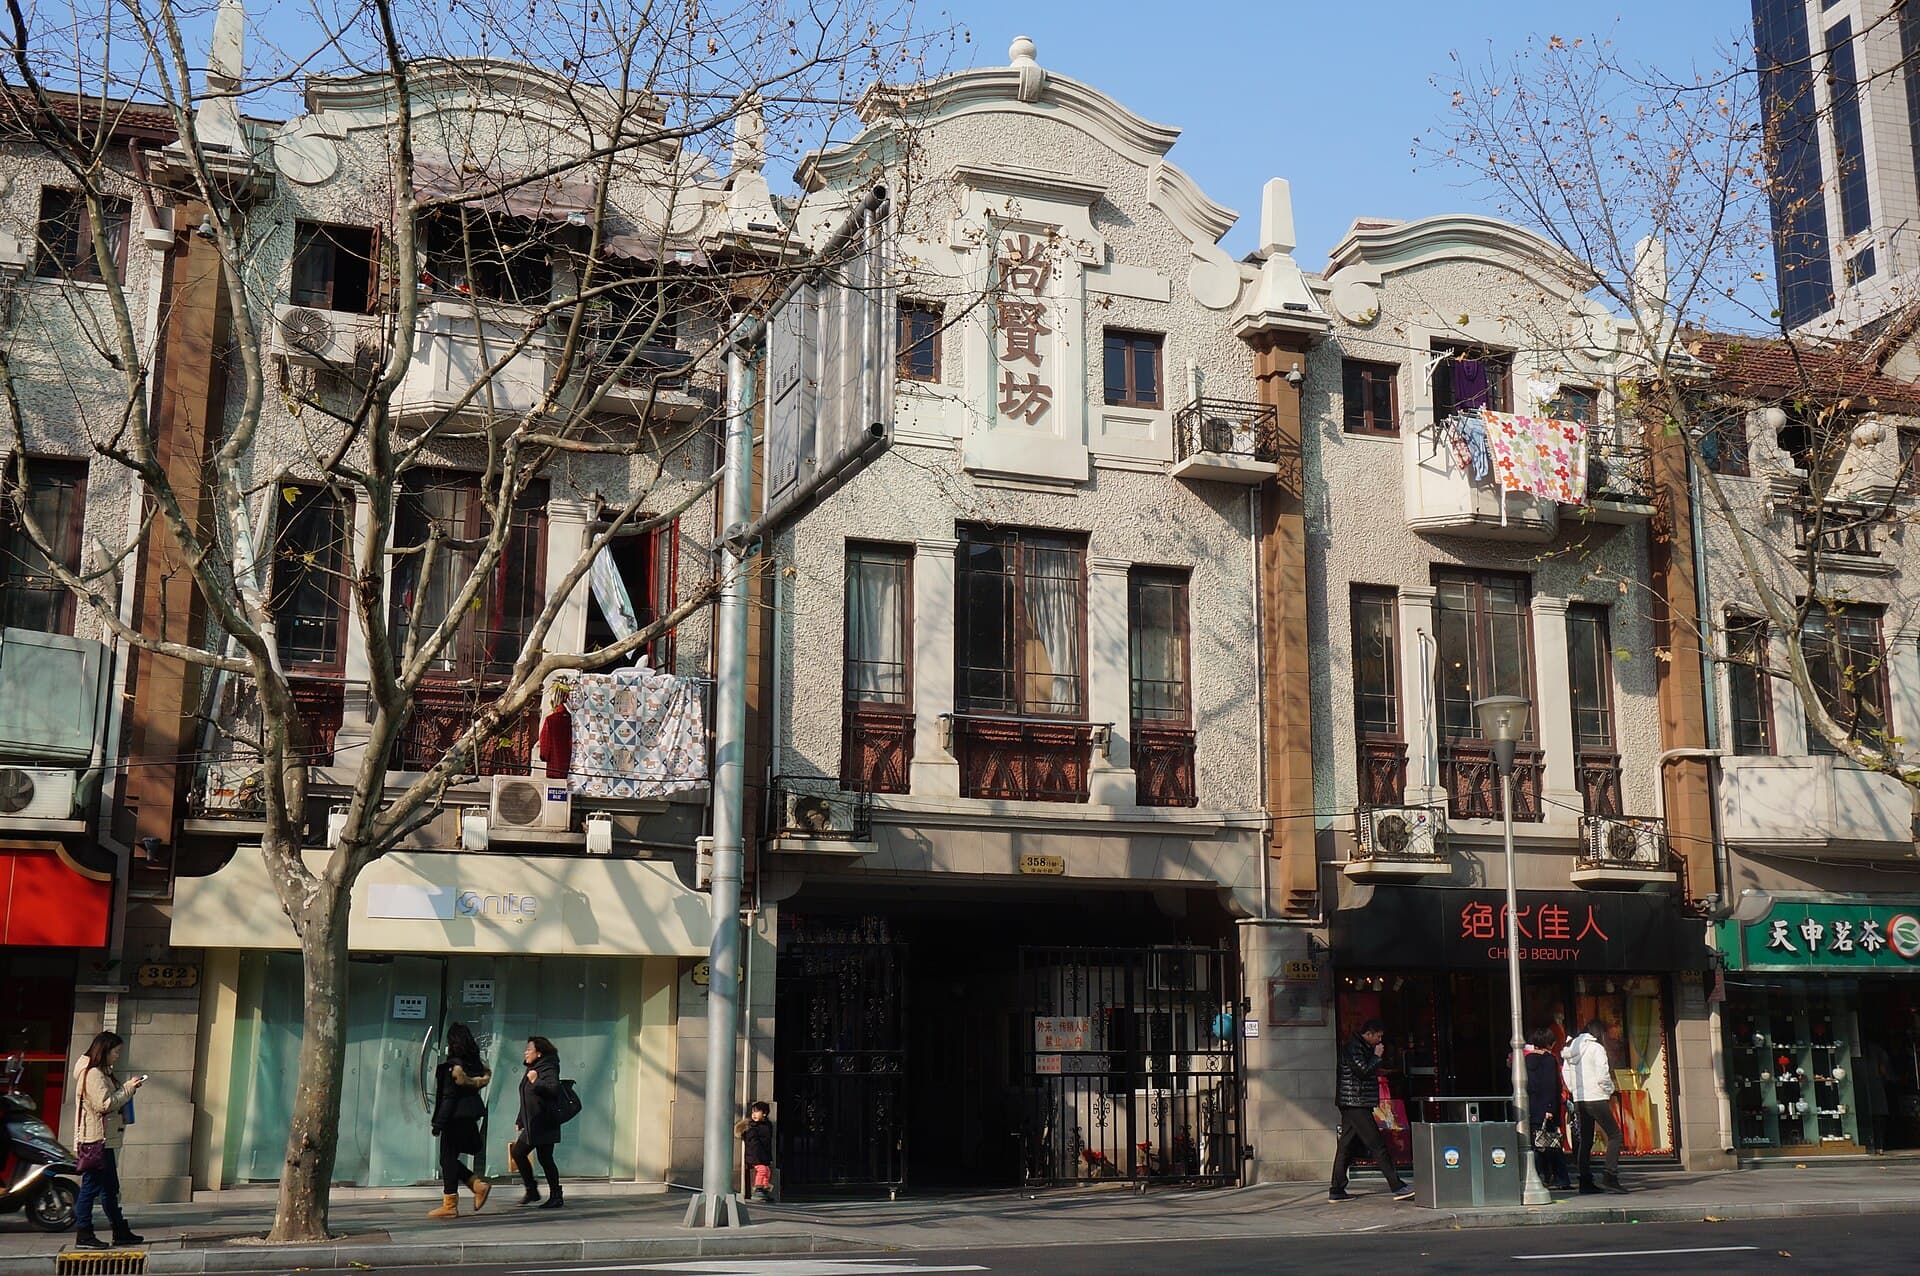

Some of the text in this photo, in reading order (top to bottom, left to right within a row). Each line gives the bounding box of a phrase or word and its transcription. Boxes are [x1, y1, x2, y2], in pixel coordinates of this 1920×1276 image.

[998, 234, 1053, 427] 尚賢坊
[1027, 857, 1046, 867] 358
[1461, 901, 1609, 941] 绝代佳人
[1767, 918, 1887, 952] 天申茗茶
[148, 967, 187, 978] 362
[1292, 963, 1318, 972] 356
